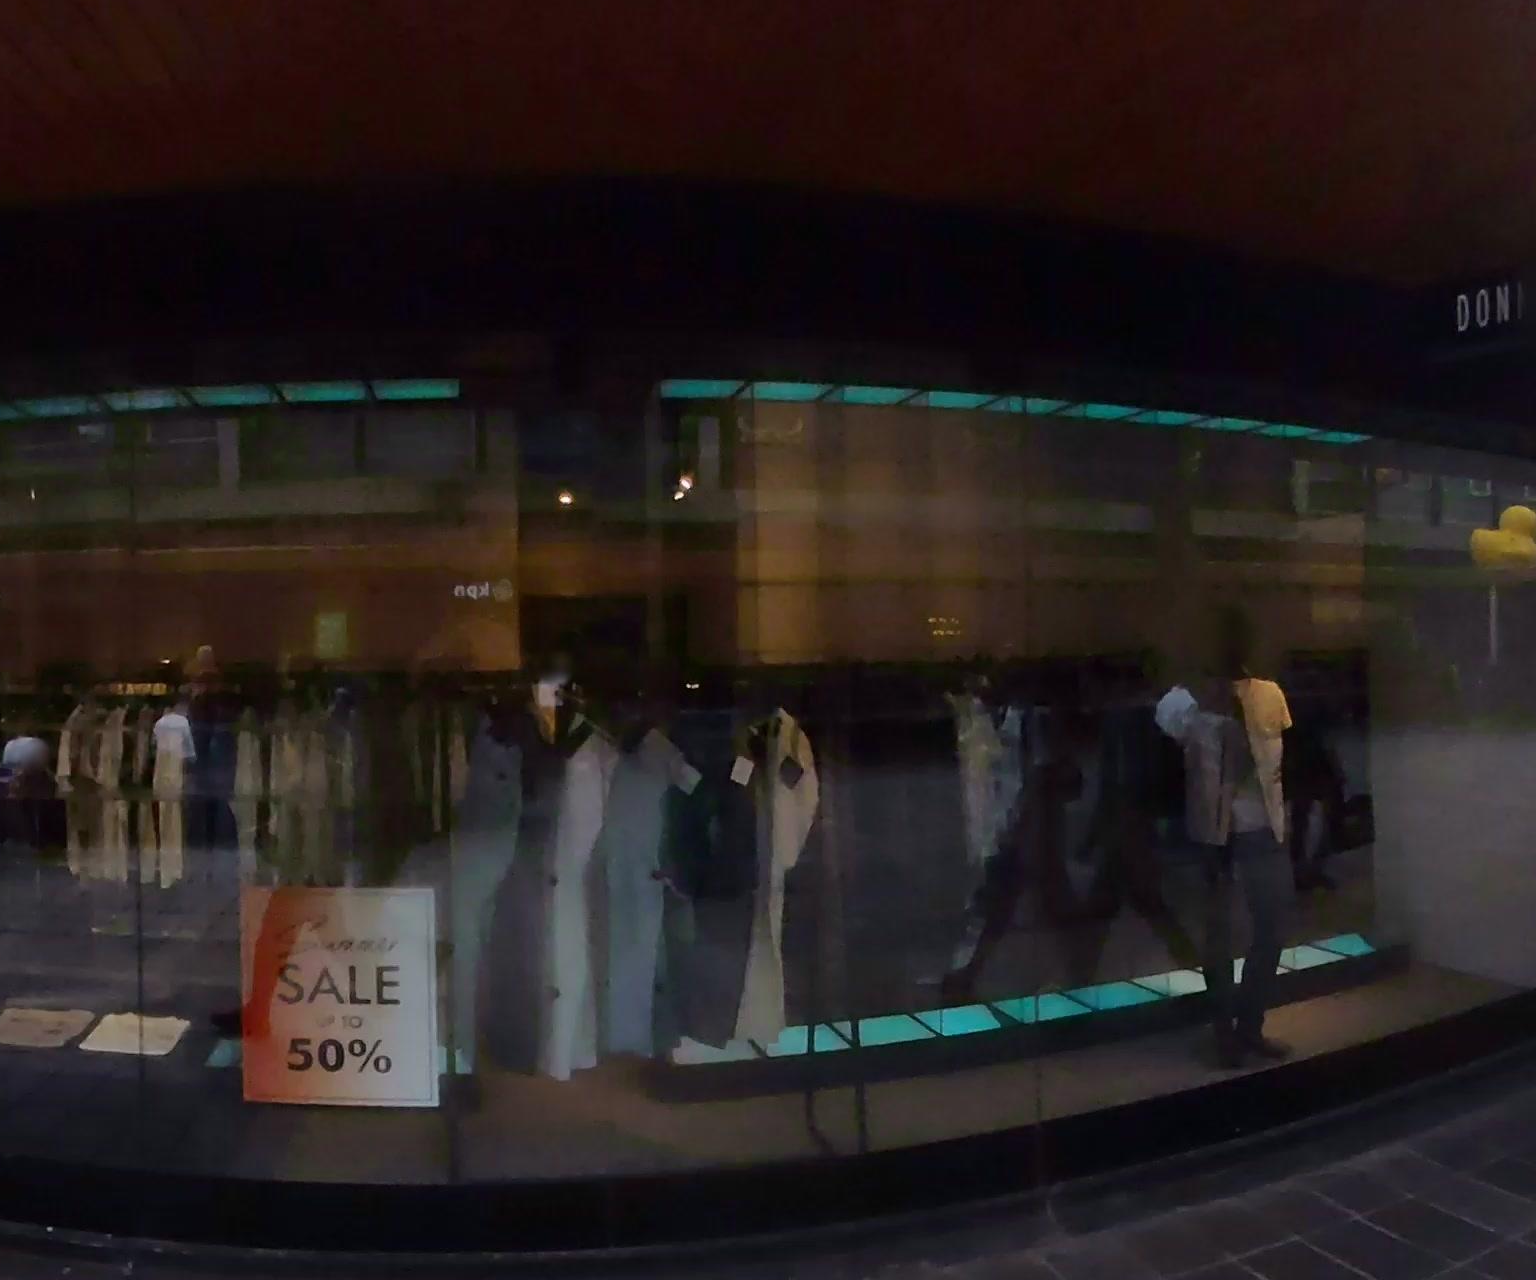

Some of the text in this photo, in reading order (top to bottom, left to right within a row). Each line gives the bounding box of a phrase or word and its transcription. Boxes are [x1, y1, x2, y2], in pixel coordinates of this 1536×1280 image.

[277, 964, 401, 1005] SALE
[341, 1015, 364, 1029] TO
[286, 1037, 393, 1074] 50%
